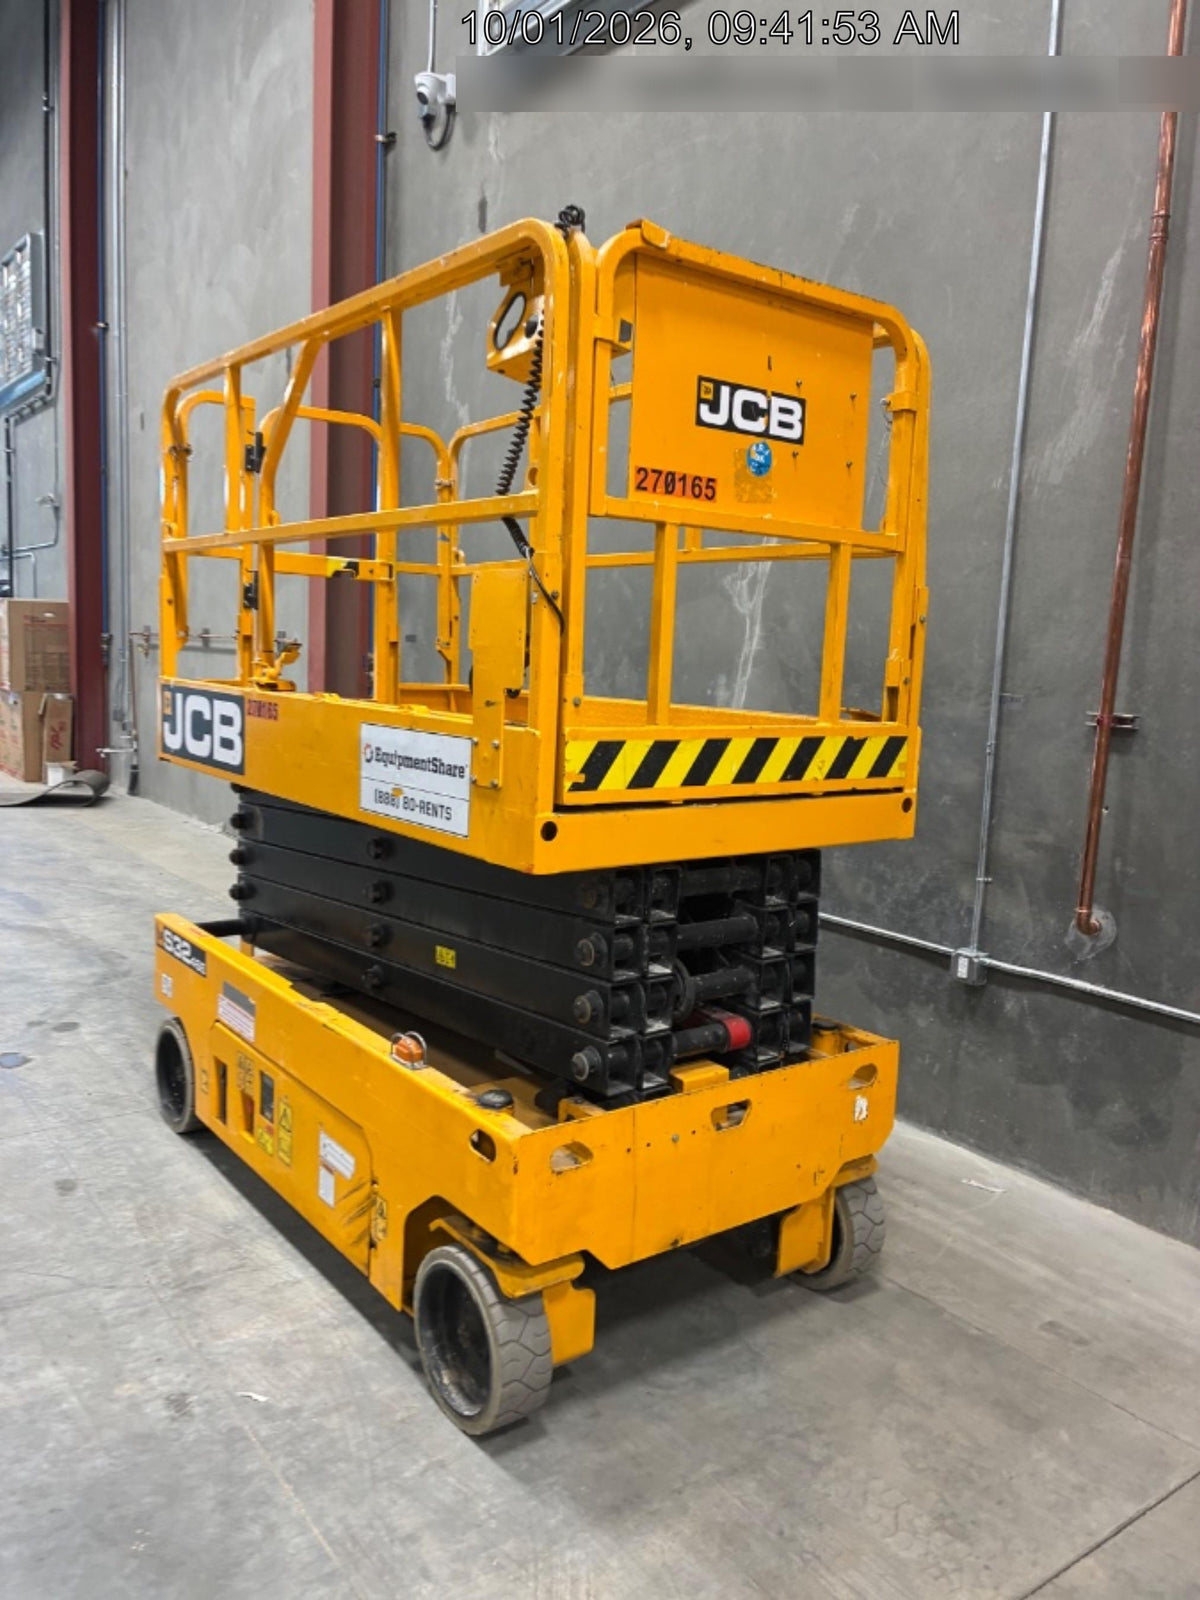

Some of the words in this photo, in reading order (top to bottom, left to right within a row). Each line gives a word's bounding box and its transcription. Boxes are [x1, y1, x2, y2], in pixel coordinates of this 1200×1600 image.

[699, 384, 803, 440] JCB
[635, 466, 717, 501] 270165
[162, 692, 243, 767] JCB
[374, 745, 466, 779] EquipmentShare
